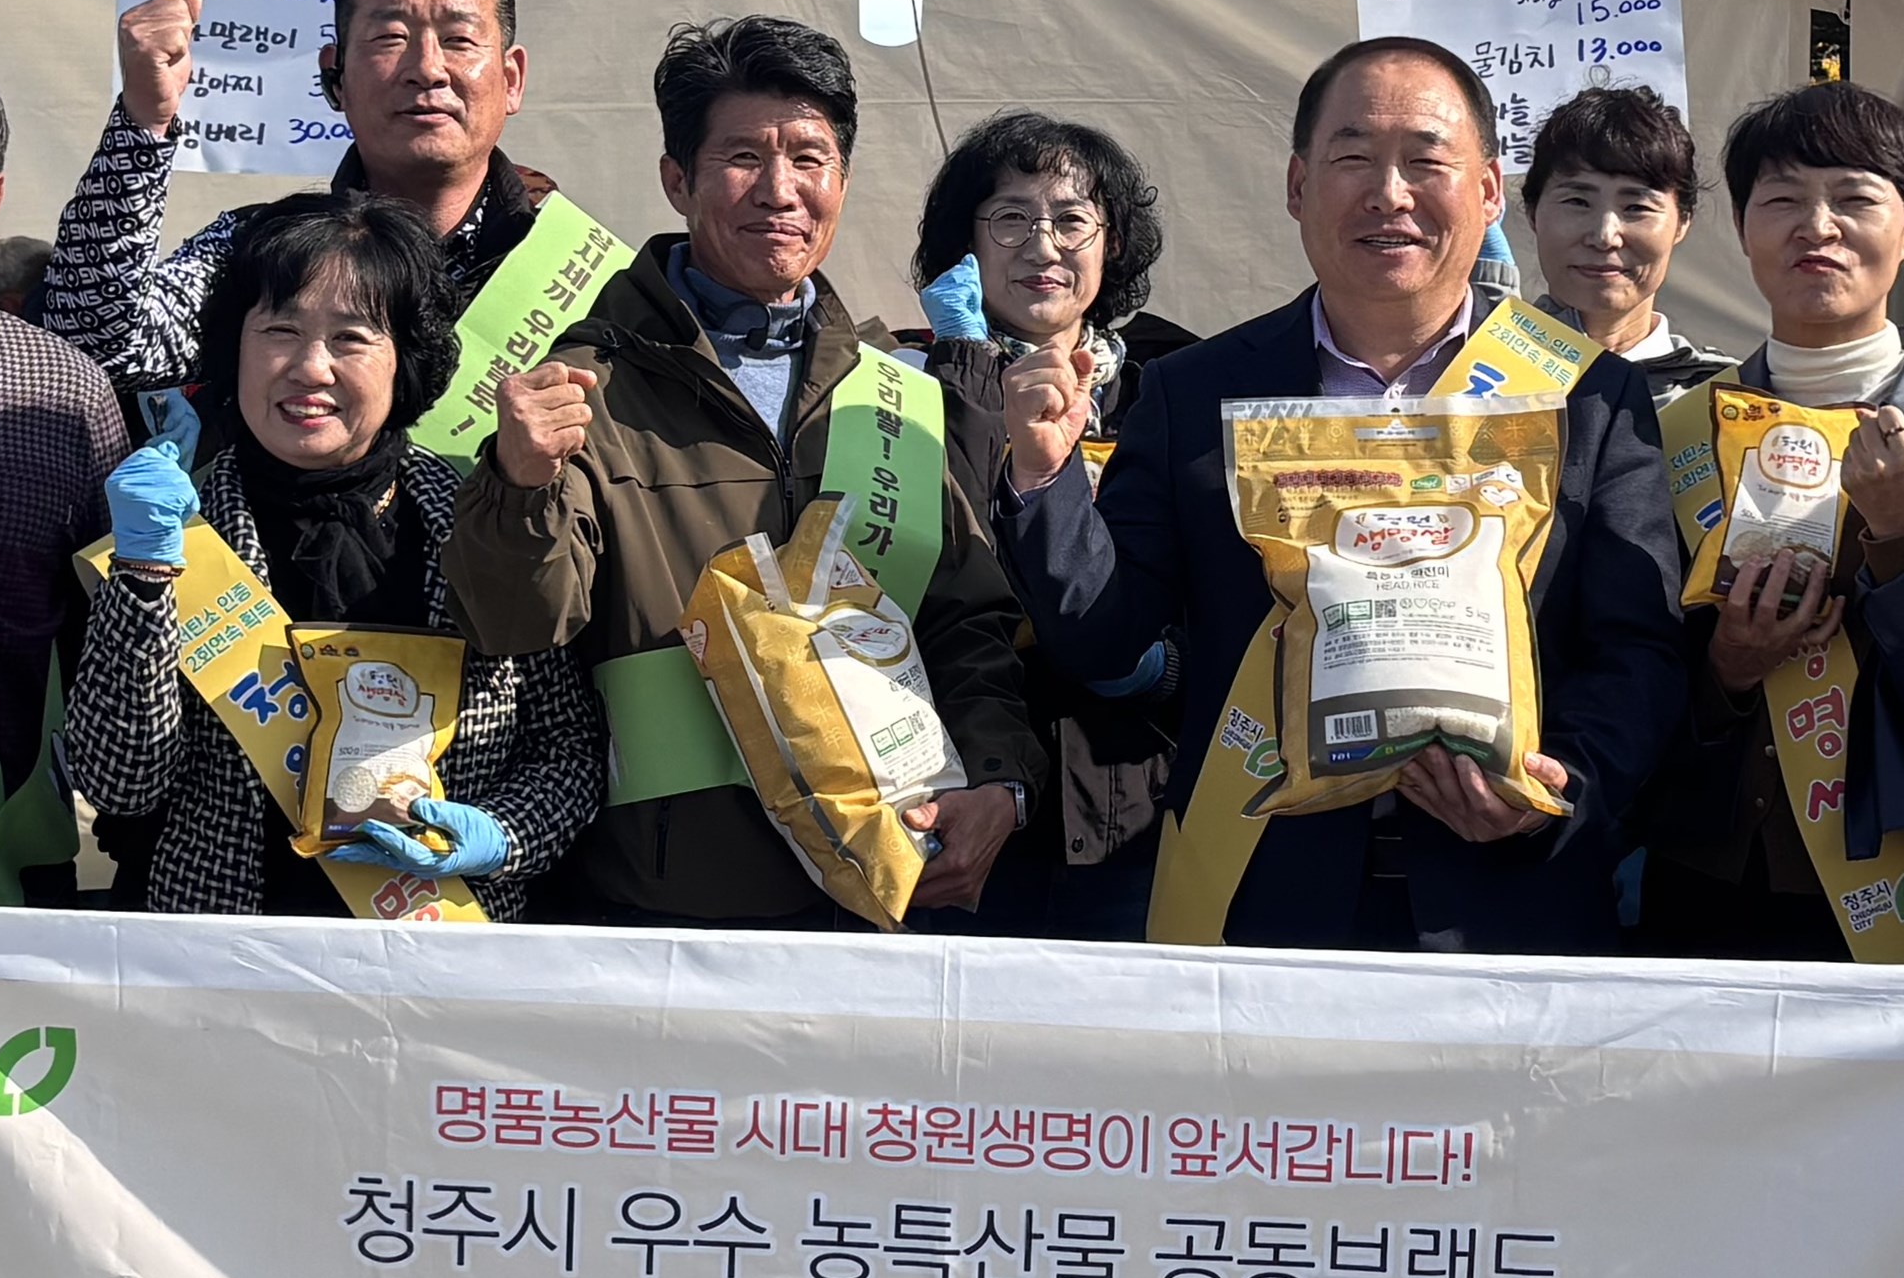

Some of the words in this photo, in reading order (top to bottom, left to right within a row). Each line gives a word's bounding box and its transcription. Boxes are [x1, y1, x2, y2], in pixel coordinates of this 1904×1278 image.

[1471, 42, 1555, 78] 물김치
[1577, 38, 1663, 63] 13.000
[543, 226, 617, 313] 삼시세끼
[1487, 322, 1541, 364] 2회연속
[858, 466, 900, 556] 우리가
[217, 582, 251, 613] 인증
[186, 625, 244, 673] 2회연속
[239, 599, 275, 629] 획득
[1844, 881, 1892, 909] 청주시
[433, 1083, 719, 1157] 명품농산물
[735, 1091, 848, 1161] 시대
[864, 1102, 1152, 1175] 청원생명이
[1167, 1117, 1473, 1187] 앞서갑니다!
[344, 1173, 577, 1274] 청주시
